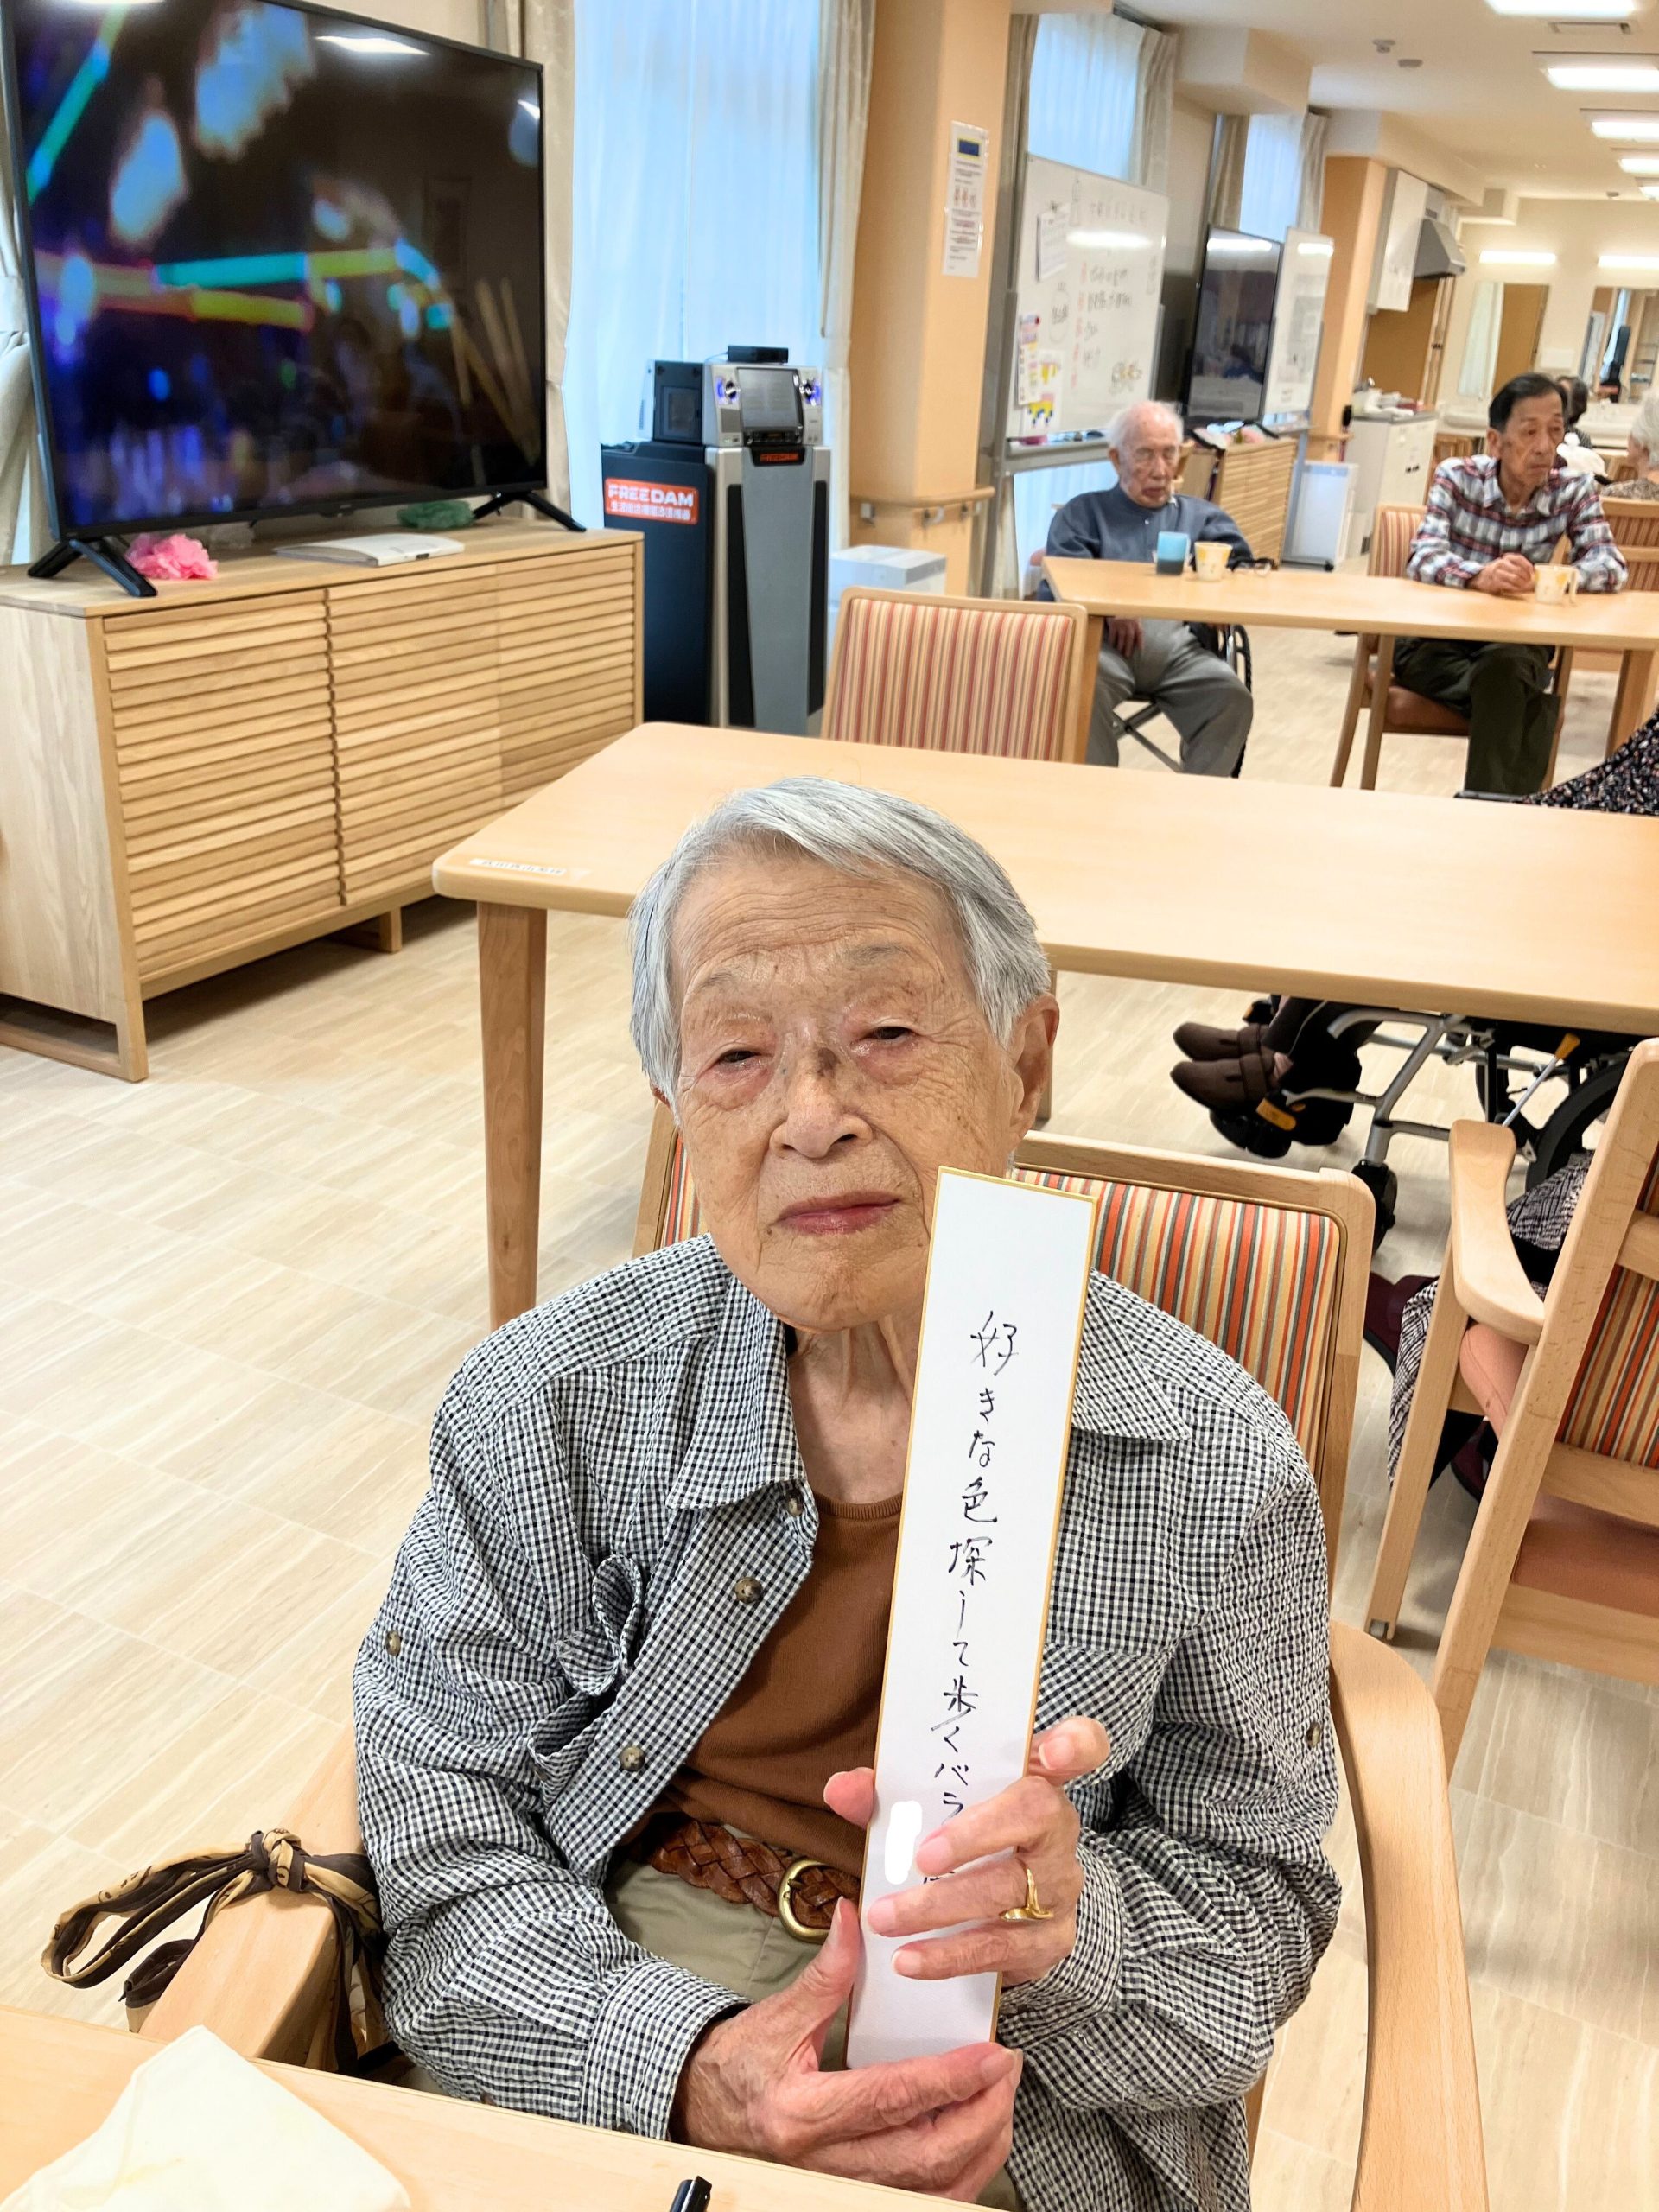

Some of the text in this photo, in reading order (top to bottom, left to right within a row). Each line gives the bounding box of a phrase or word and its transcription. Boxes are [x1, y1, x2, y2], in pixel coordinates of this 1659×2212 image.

[608, 484, 694, 507] FREEDAM
[924, 1310, 1019, 1884] 好きな色探して歩くバラ
